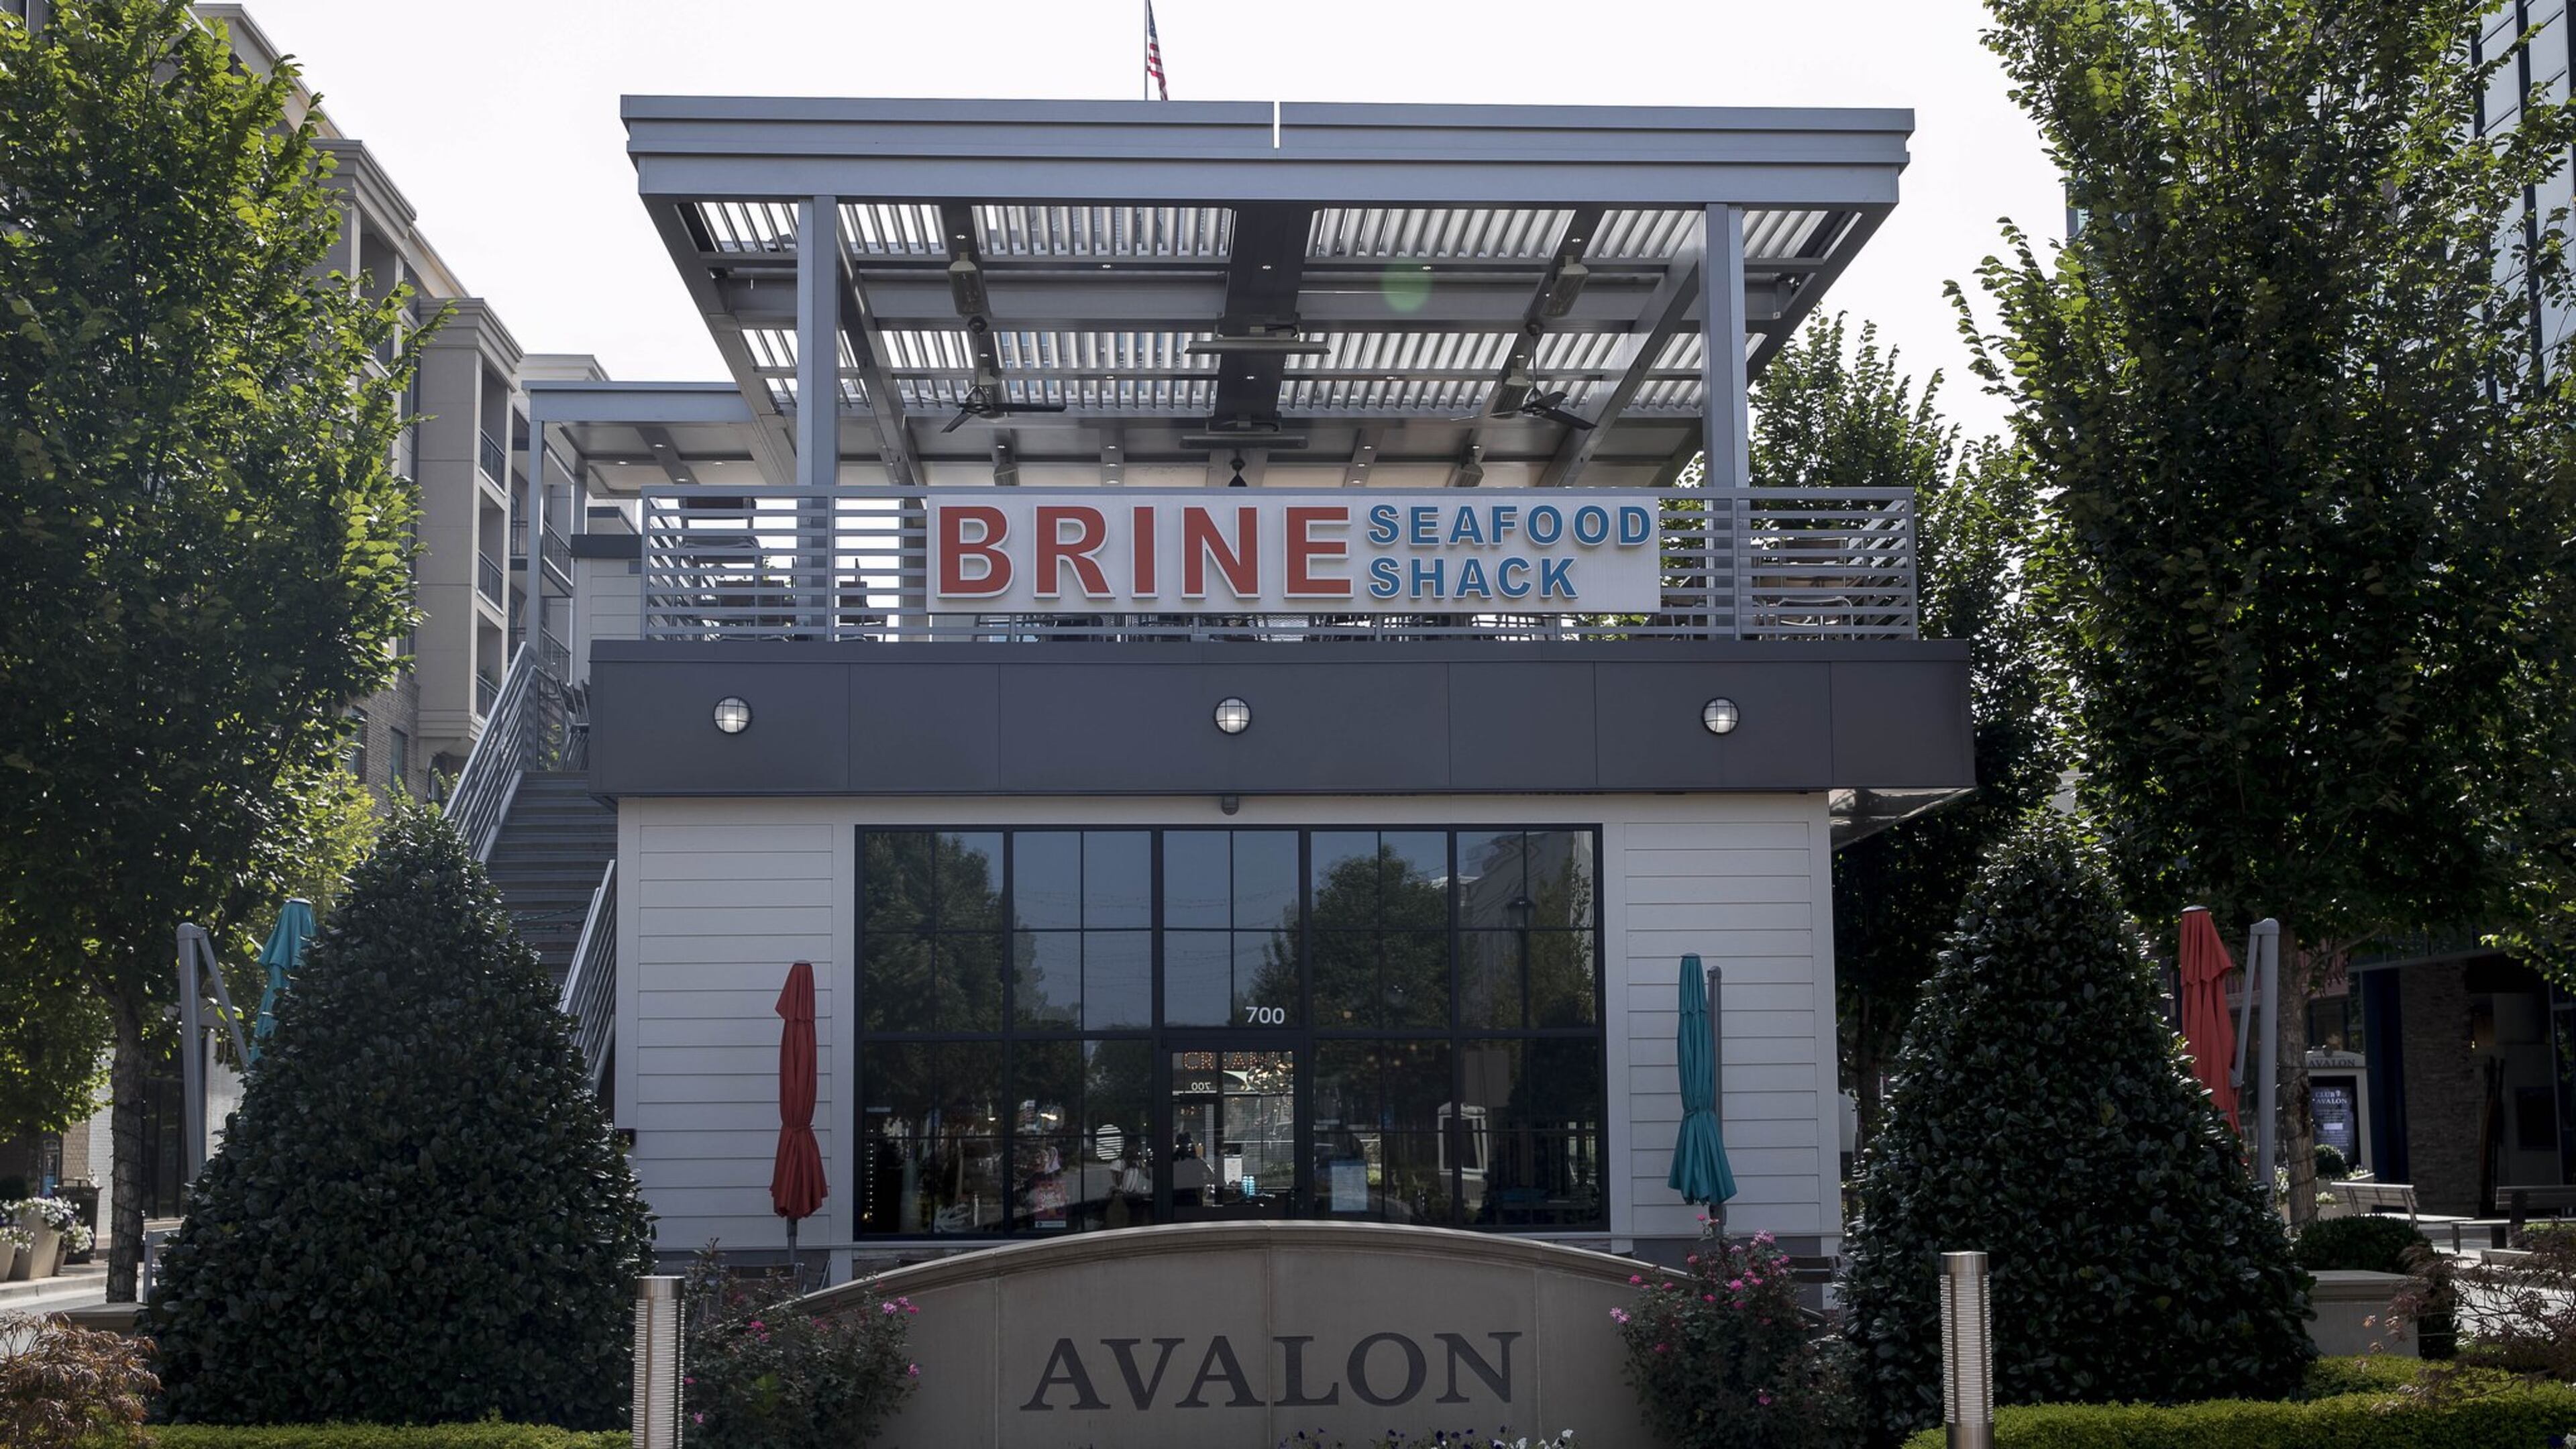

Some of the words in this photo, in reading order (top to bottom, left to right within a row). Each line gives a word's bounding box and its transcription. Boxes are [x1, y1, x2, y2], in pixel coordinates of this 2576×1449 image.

[1368, 504, 1652, 546] SEAFOOD
[936, 505, 1354, 599] BRINE
[1368, 557, 1578, 600] SHACK
[1246, 1006, 1285, 1024] 700
[2308, 1059, 2356, 1068] AVALON
[1019, 1331, 1523, 1411] AVALON
